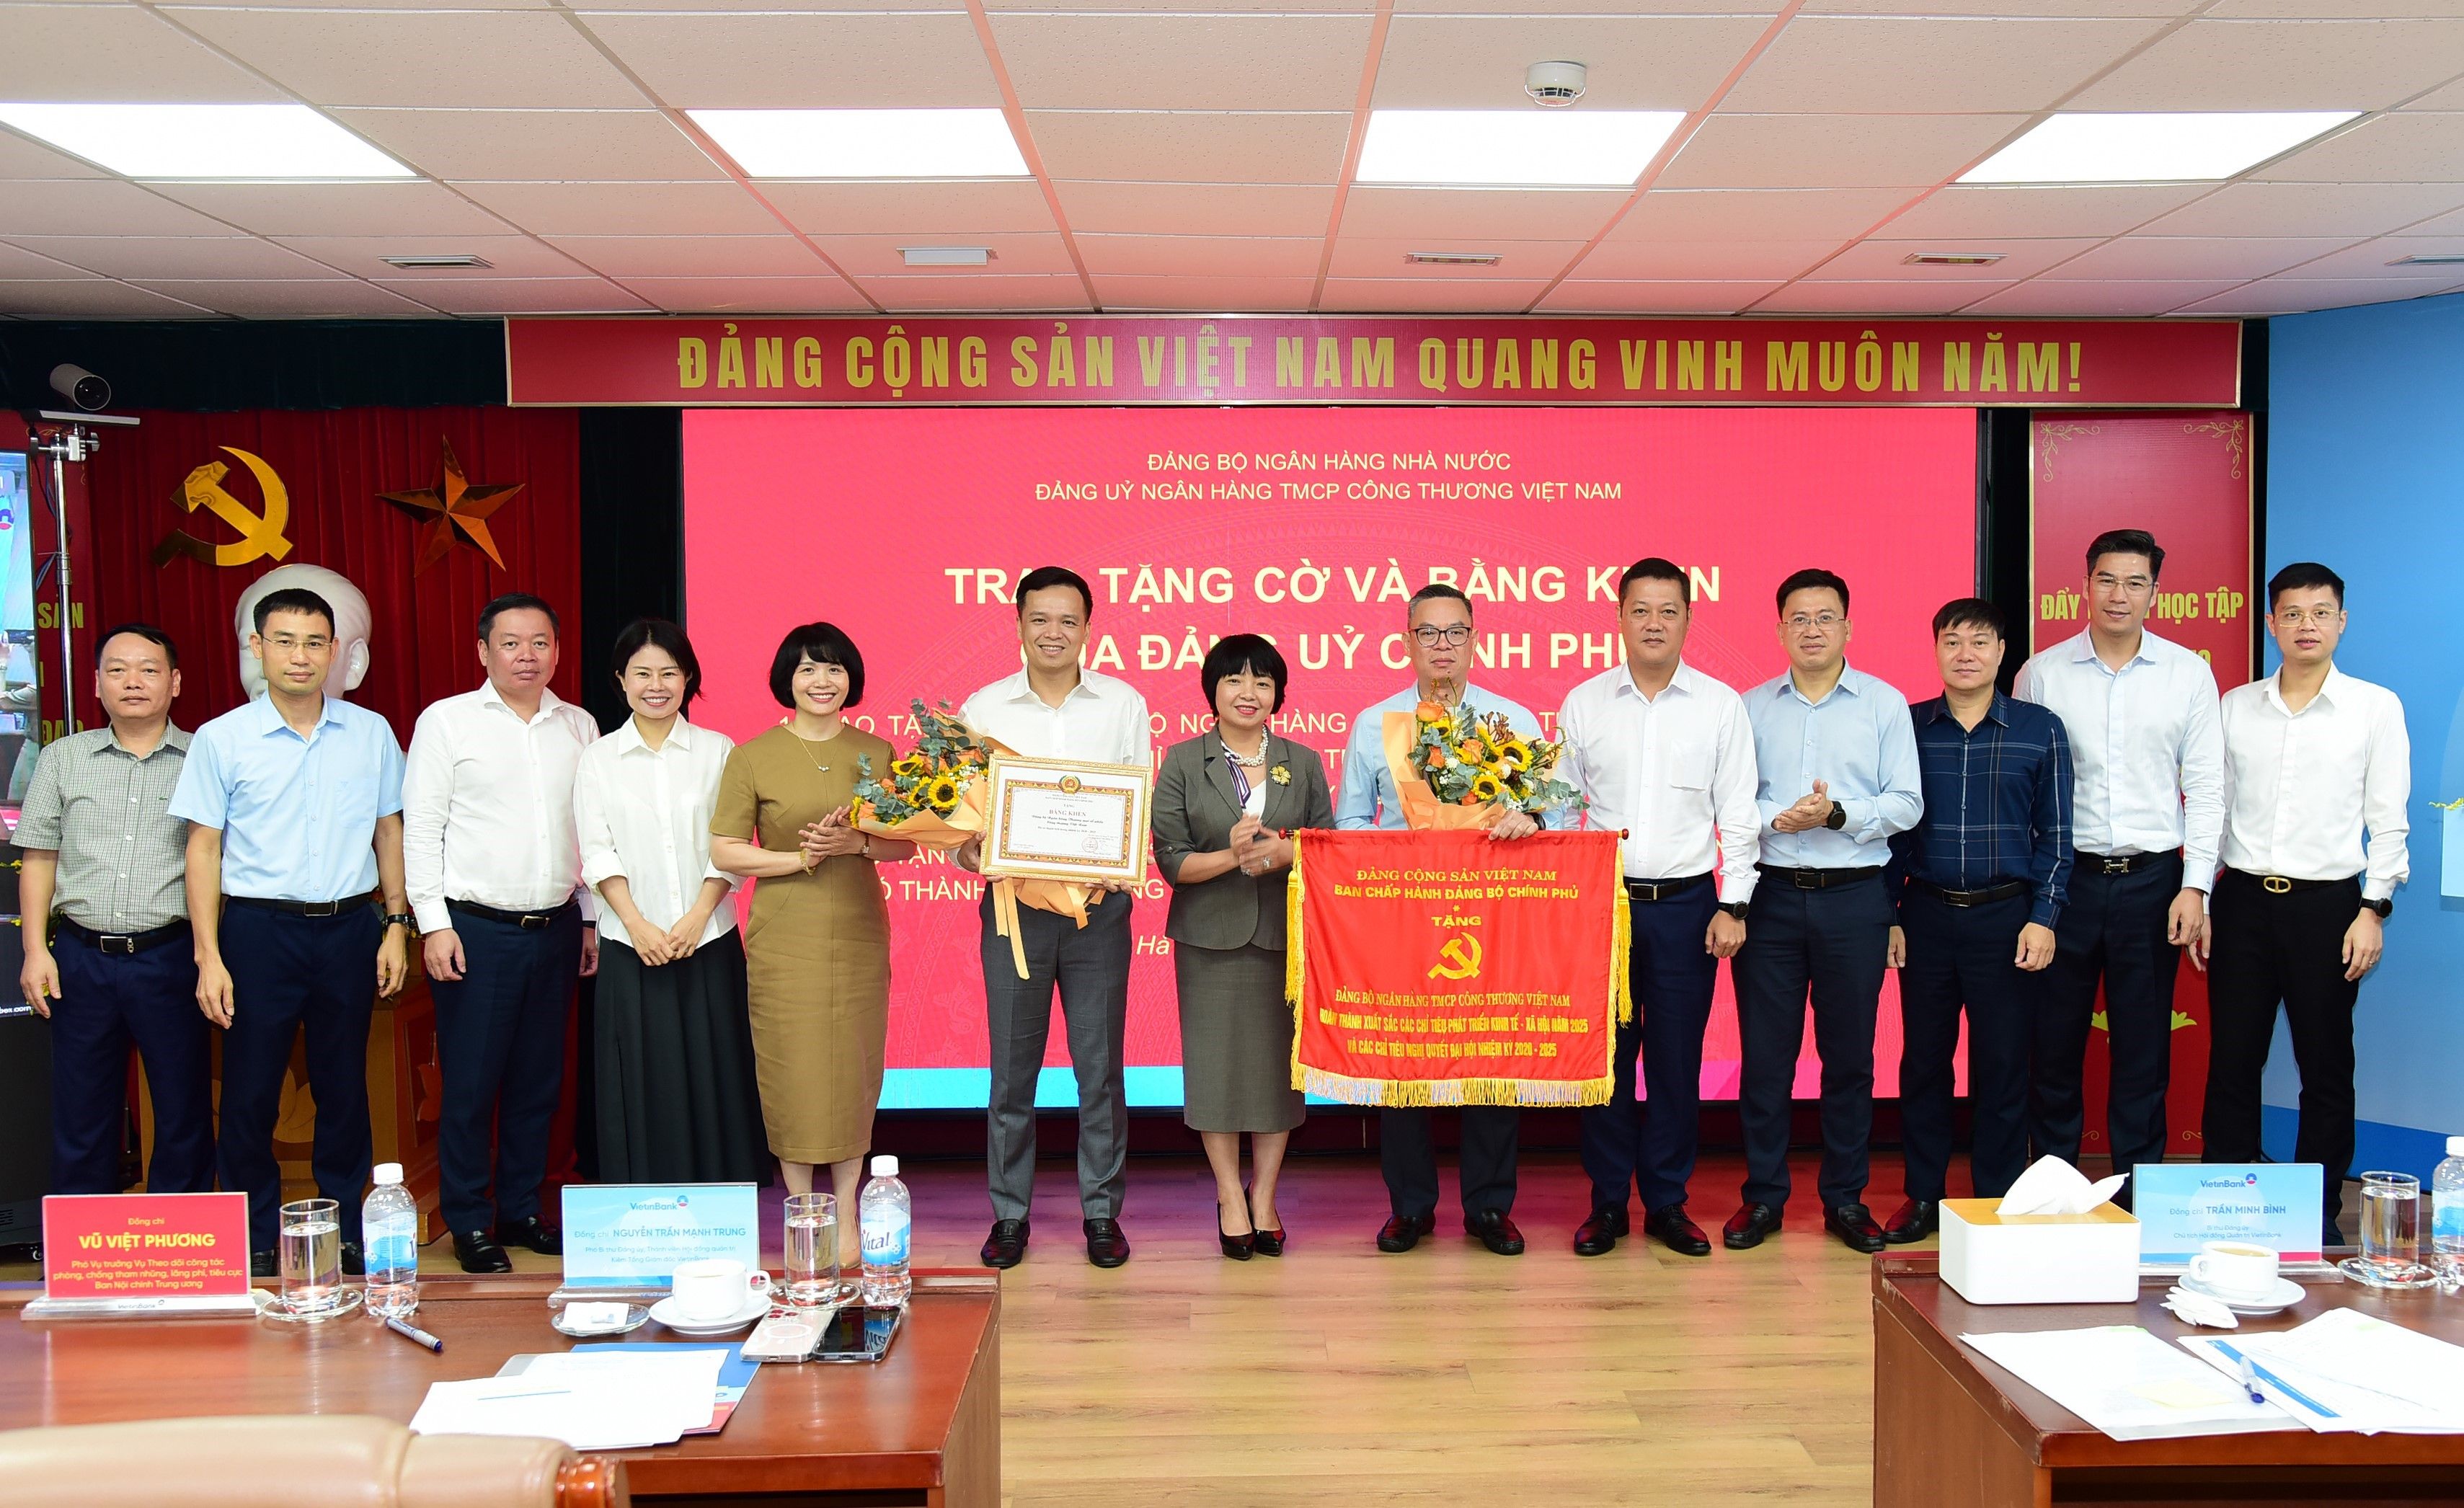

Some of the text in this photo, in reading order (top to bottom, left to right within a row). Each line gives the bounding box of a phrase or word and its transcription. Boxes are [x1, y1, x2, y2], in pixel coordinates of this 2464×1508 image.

[678, 322, 2082, 397] ĐẢNG CỘNG SẢN VIỆT NAM QUANG VINH MUÔN NĂM!
[1147, 449, 1511, 474] ĐẢNG BỘ NGÂN HÀNG NHÀ NƯỚC
[1035, 479, 1621, 502] ĐẢNG UỶ NGÂN HÀNG TMCP CÔNG THƯƠNG VIỆT NAM
[1099, 563, 1233, 613] TẶNG
[1254, 558, 1331, 603] CỜ
[1344, 558, 1412, 603] VÀ
[1587, 566, 1719, 602] KN
[2041, 587, 2243, 624] ĐẨY HỌC TẬP
[1137, 625, 1277, 670] ĐẢ
[1299, 624, 1365, 670] UỶ
[1380, 633, 1530, 670] CNH
[1551, 633, 1629, 669] PH
[1357, 866, 1556, 884] ĐẢNG CỘNG SẢN VIỆT NAM
[1334, 884, 1579, 900] BAN CHẤP HÀNH ĐẢNG BỘ CHÍNH PHỦ
[1431, 915, 1481, 928] TẶNG
[1136, 935, 1170, 955] Hà
[1335, 985, 1570, 1009] ĐẢNG BỘ NGÂN HÀNG TMCP CÔNG THƯƠNG VIỆT NAM
[1339, 1011, 1362, 1029] THÀNH
[1363, 1011, 1381, 1031] XUẤT
[1383, 1013, 1399, 1032] SẮC
[1400, 1015, 1414, 1032] CÁC
[1417, 1014, 1429, 1032] CHỈ
[1431, 1016, 1447, 1034] TIÊU
[1448, 1015, 1467, 1032] PHÁT
[1491, 1016, 1509, 1032] KINH
[1510, 1012, 1520, 1032] TẾ
[1525, 1015, 1535, 1032] XÃ
[1537, 1015, 1550, 1034] HỘI
[1551, 1015, 1569, 1032] NĂM
[1570, 1019, 1588, 1033] 2025
[1347, 1037, 1557, 1060] VÀ CÁC CHỈ TIÊU NGHỊ QUYẾT ĐẠI HỘI NHIỆM KỲ 2020 2025
[2200, 1179, 2246, 1188] VietinBank
[2263, 1204, 2286, 1214] BÌNH
[79, 1231, 216, 1251] VŨ VIỆT PHƯƠNG
[683, 1228, 711, 1238] MẠNH
[713, 1228, 746, 1236] TRUNG
[89, 1261, 102, 1269] Vụ
[186, 1259, 208, 1269] công
[115, 1269, 138, 1279] tham
[94, 1280, 112, 1290] Ban
[156, 1279, 179, 1290] Trung
